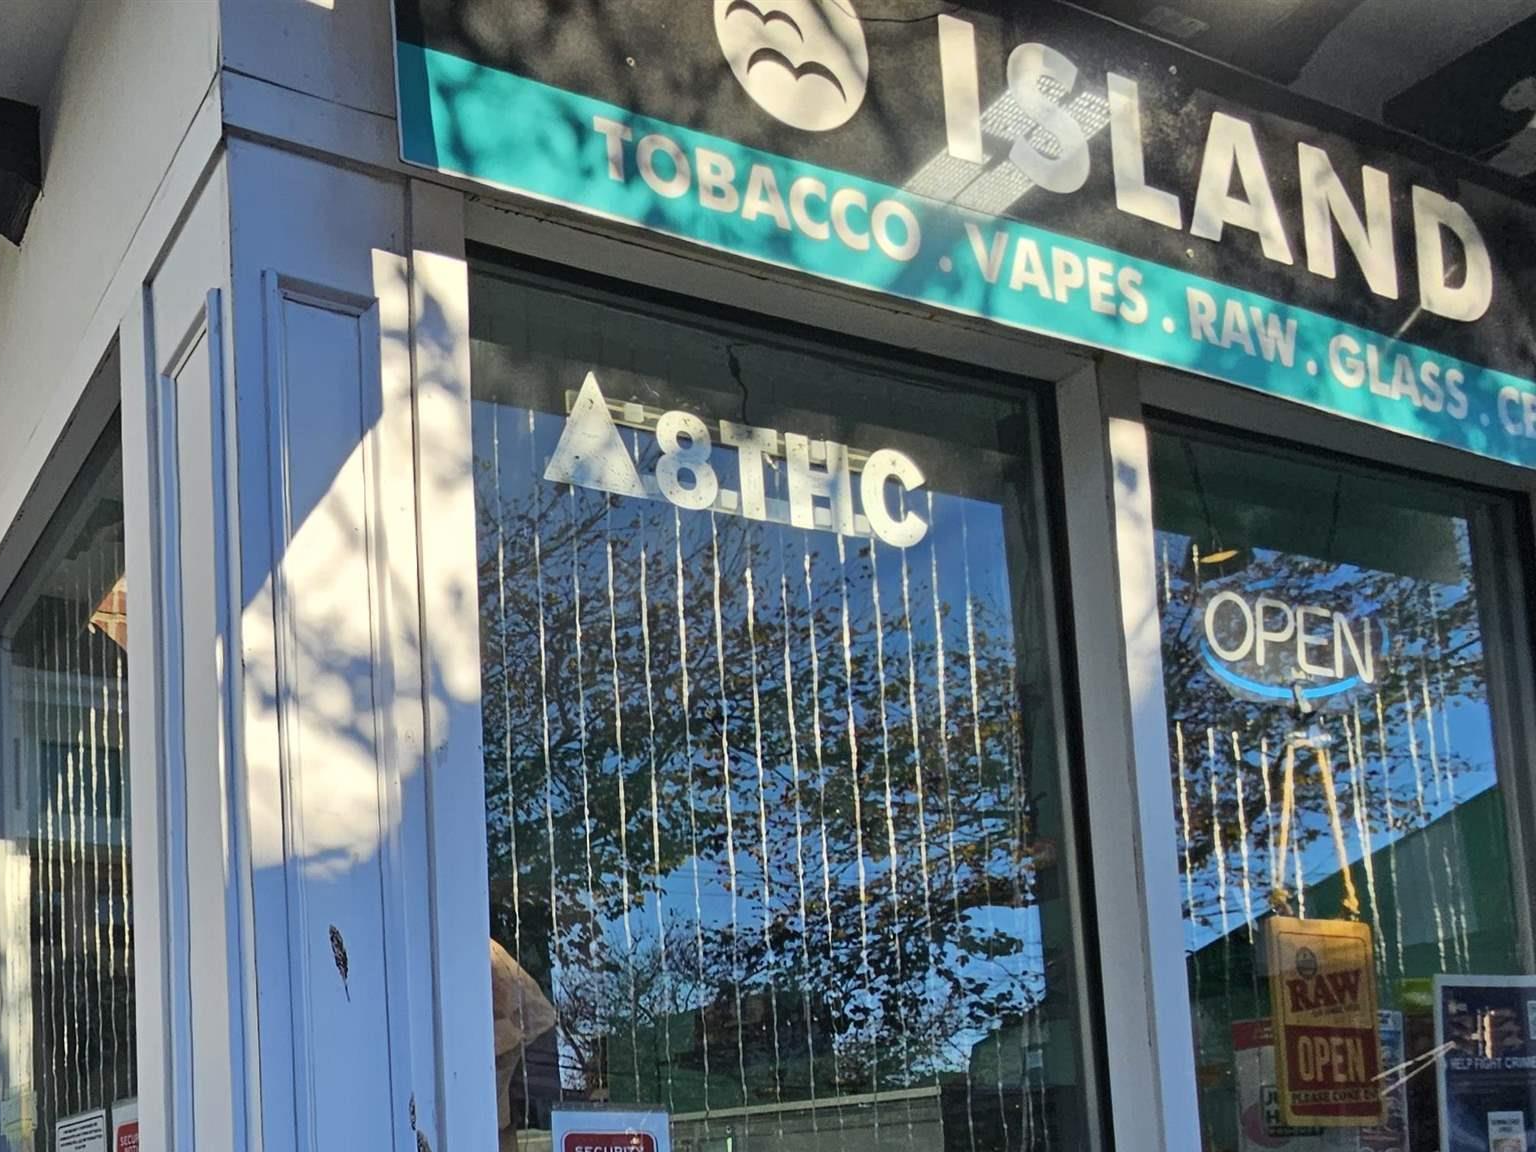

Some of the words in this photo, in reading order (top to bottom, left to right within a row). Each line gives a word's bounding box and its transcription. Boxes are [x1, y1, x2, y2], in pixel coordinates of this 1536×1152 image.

[938, 13, 1492, 322] ISLAND
[593, 115, 921, 261] TOBACCO
[964, 223, 1148, 324] VAPES
[1186, 286, 1297, 368] RAW
[1329, 333, 1468, 419] GLASS
[1204, 591, 1375, 684] OPEN
[1286, 969, 1362, 1013] RAW
[1298, 1035, 1364, 1083] OPEN
